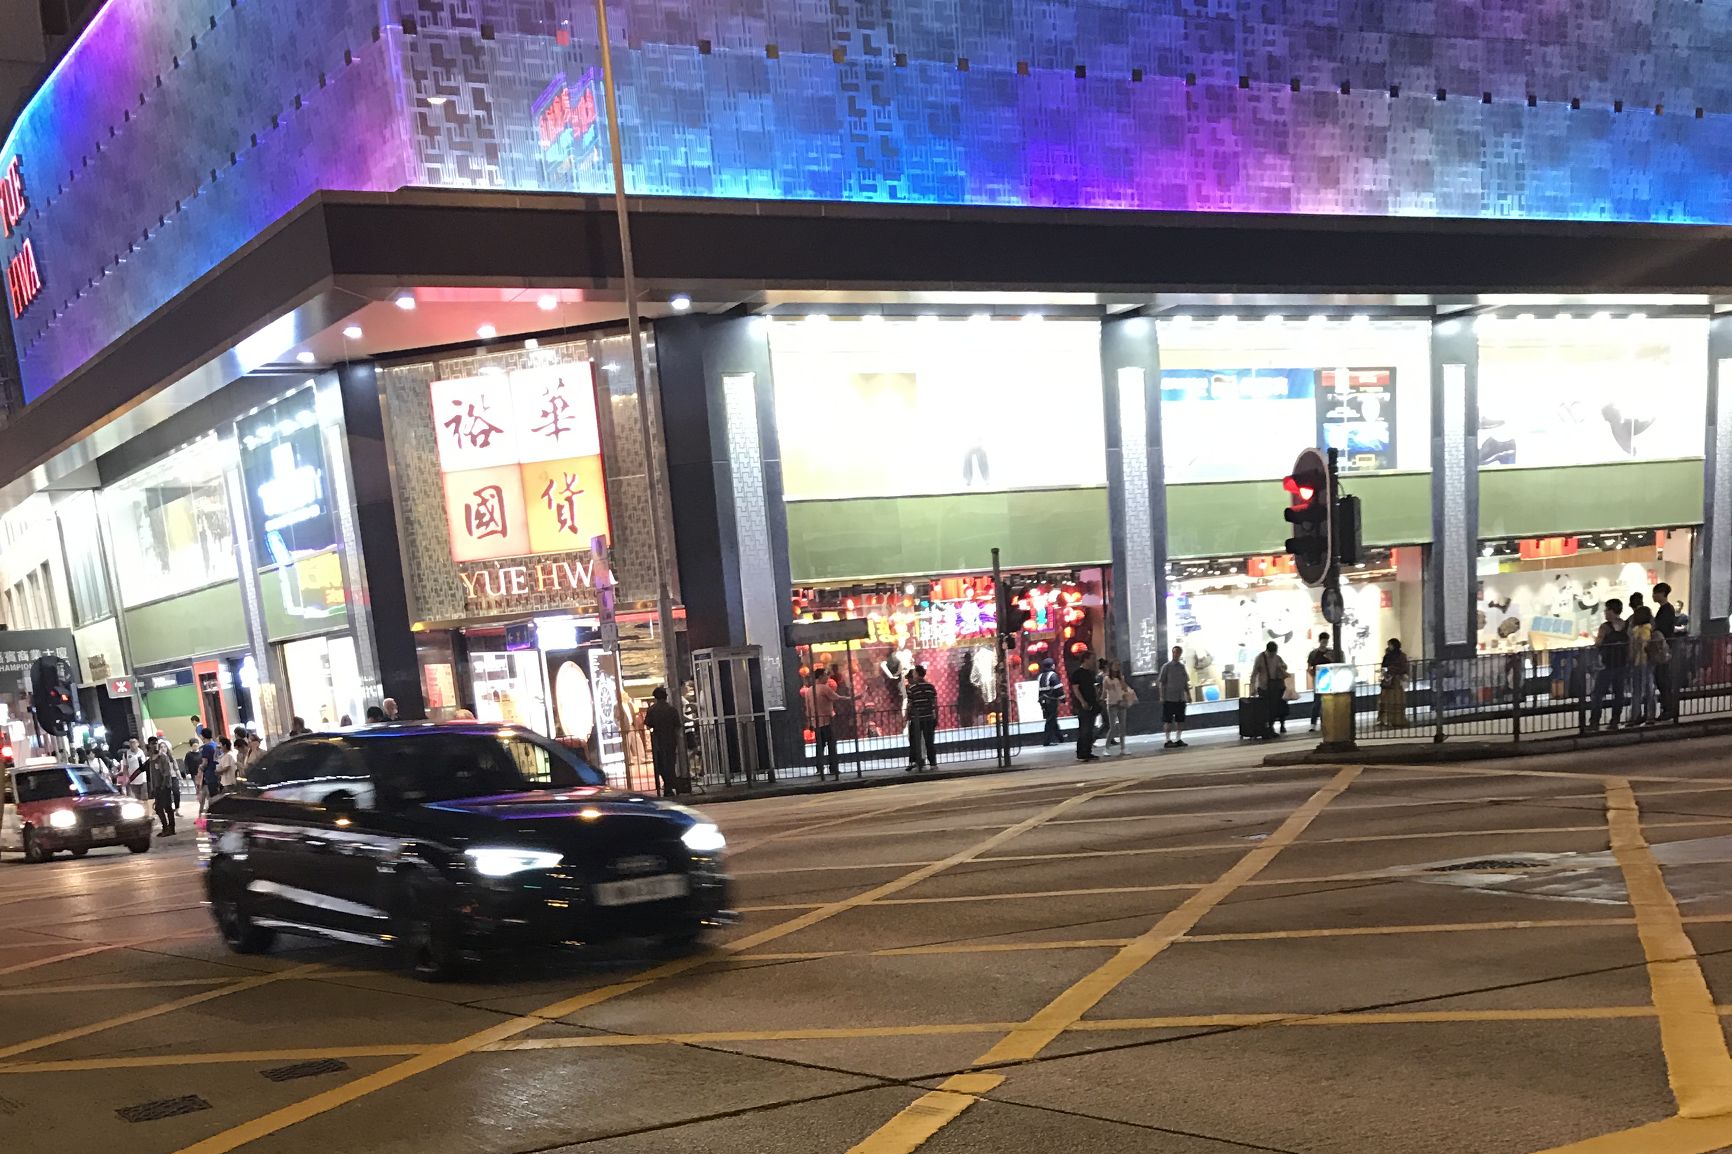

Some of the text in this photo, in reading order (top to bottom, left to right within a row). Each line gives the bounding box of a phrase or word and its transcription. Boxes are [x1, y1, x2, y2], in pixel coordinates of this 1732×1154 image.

[8, 238, 41, 319] HWA
[444, 378, 576, 449] 裕華
[465, 472, 584, 540] 國貨
[460, 566, 528, 598] YUE
